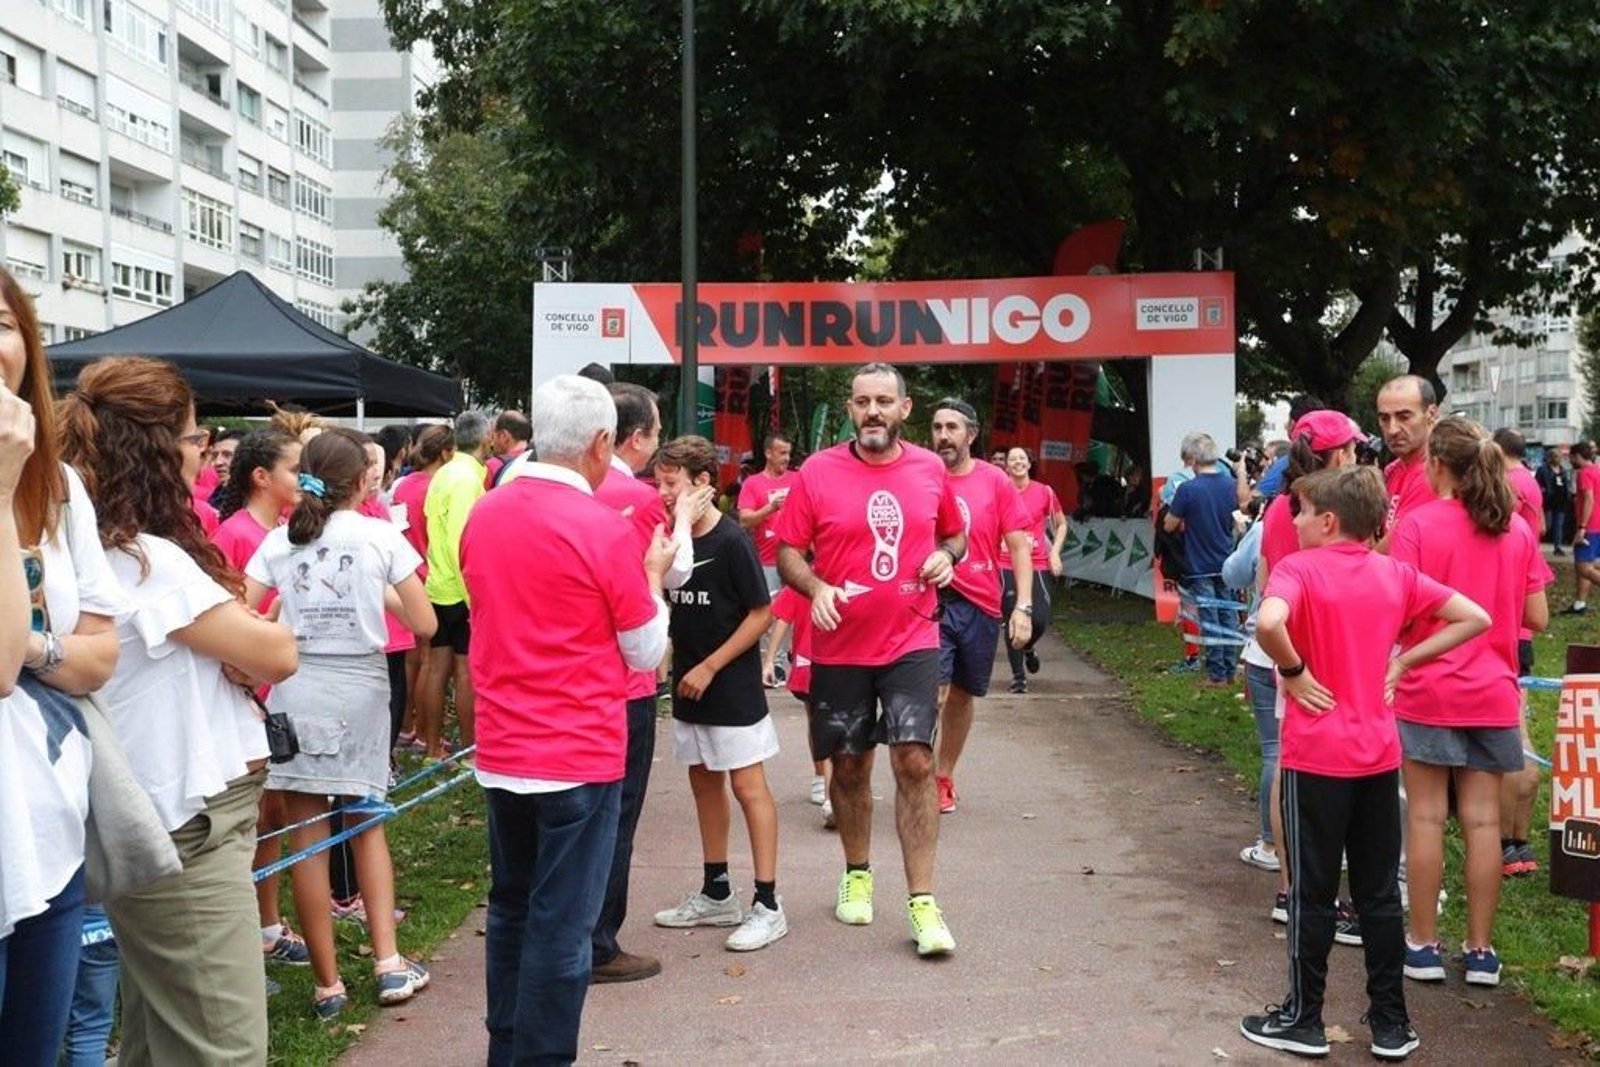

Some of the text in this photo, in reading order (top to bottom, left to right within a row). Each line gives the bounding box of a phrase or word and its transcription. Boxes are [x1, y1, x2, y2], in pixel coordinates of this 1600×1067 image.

[1140, 304, 1195, 314] CONCELLO
[545, 313, 595, 323] CONCELLO
[1147, 314, 1188, 323] DE VIGO
[551, 323, 590, 332] DE VIGO
[680, 590, 695, 605] DO
[697, 591, 712, 606] IT.
